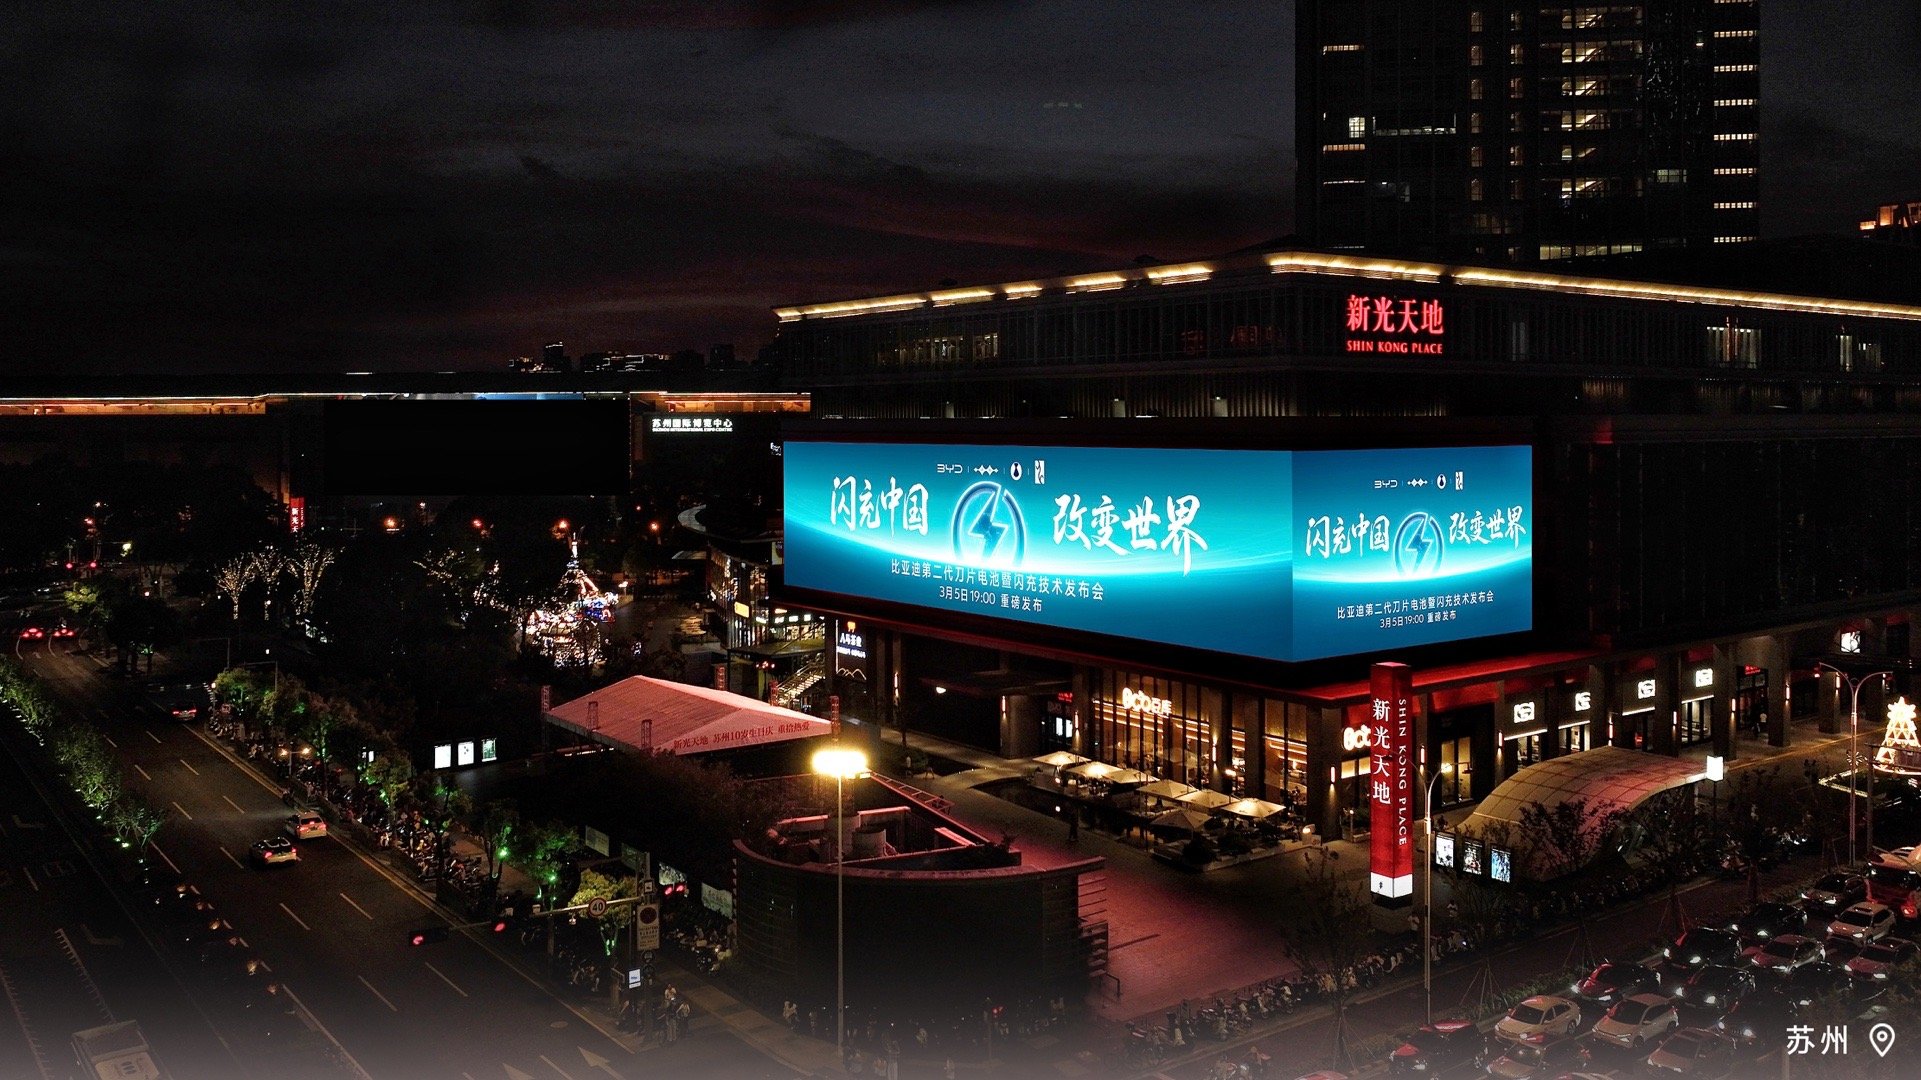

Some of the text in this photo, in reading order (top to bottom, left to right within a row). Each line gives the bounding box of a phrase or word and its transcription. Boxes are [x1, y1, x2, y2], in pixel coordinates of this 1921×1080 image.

[1346, 294, 1444, 334] 新光天地
[1346, 340, 1443, 354] SHIN KONG PLACE
[936, 463, 963, 474] BYD
[1374, 479, 1398, 488] BYD
[830, 476, 1209, 577] 闪充中国 改变世界
[1305, 505, 1527, 559] 闪充中国 改变世界
[891, 558, 1104, 601] 比亚迪第二代刀片电池暨闪充技术发布会
[939, 586, 1042, 613] 3月5日19:00 重磅发布
[1337, 590, 1494, 619] 比亚迪第二代刀片电池暨闪充技术发布会
[1379, 610, 1457, 629] 3月5日19:00 重磅发布
[673, 735, 709, 750] 新光天地
[1372, 698, 1391, 804] 新光天地
[1398, 698, 1407, 846] SHIN KONG PLACE
[593, 903, 603, 912] 40
